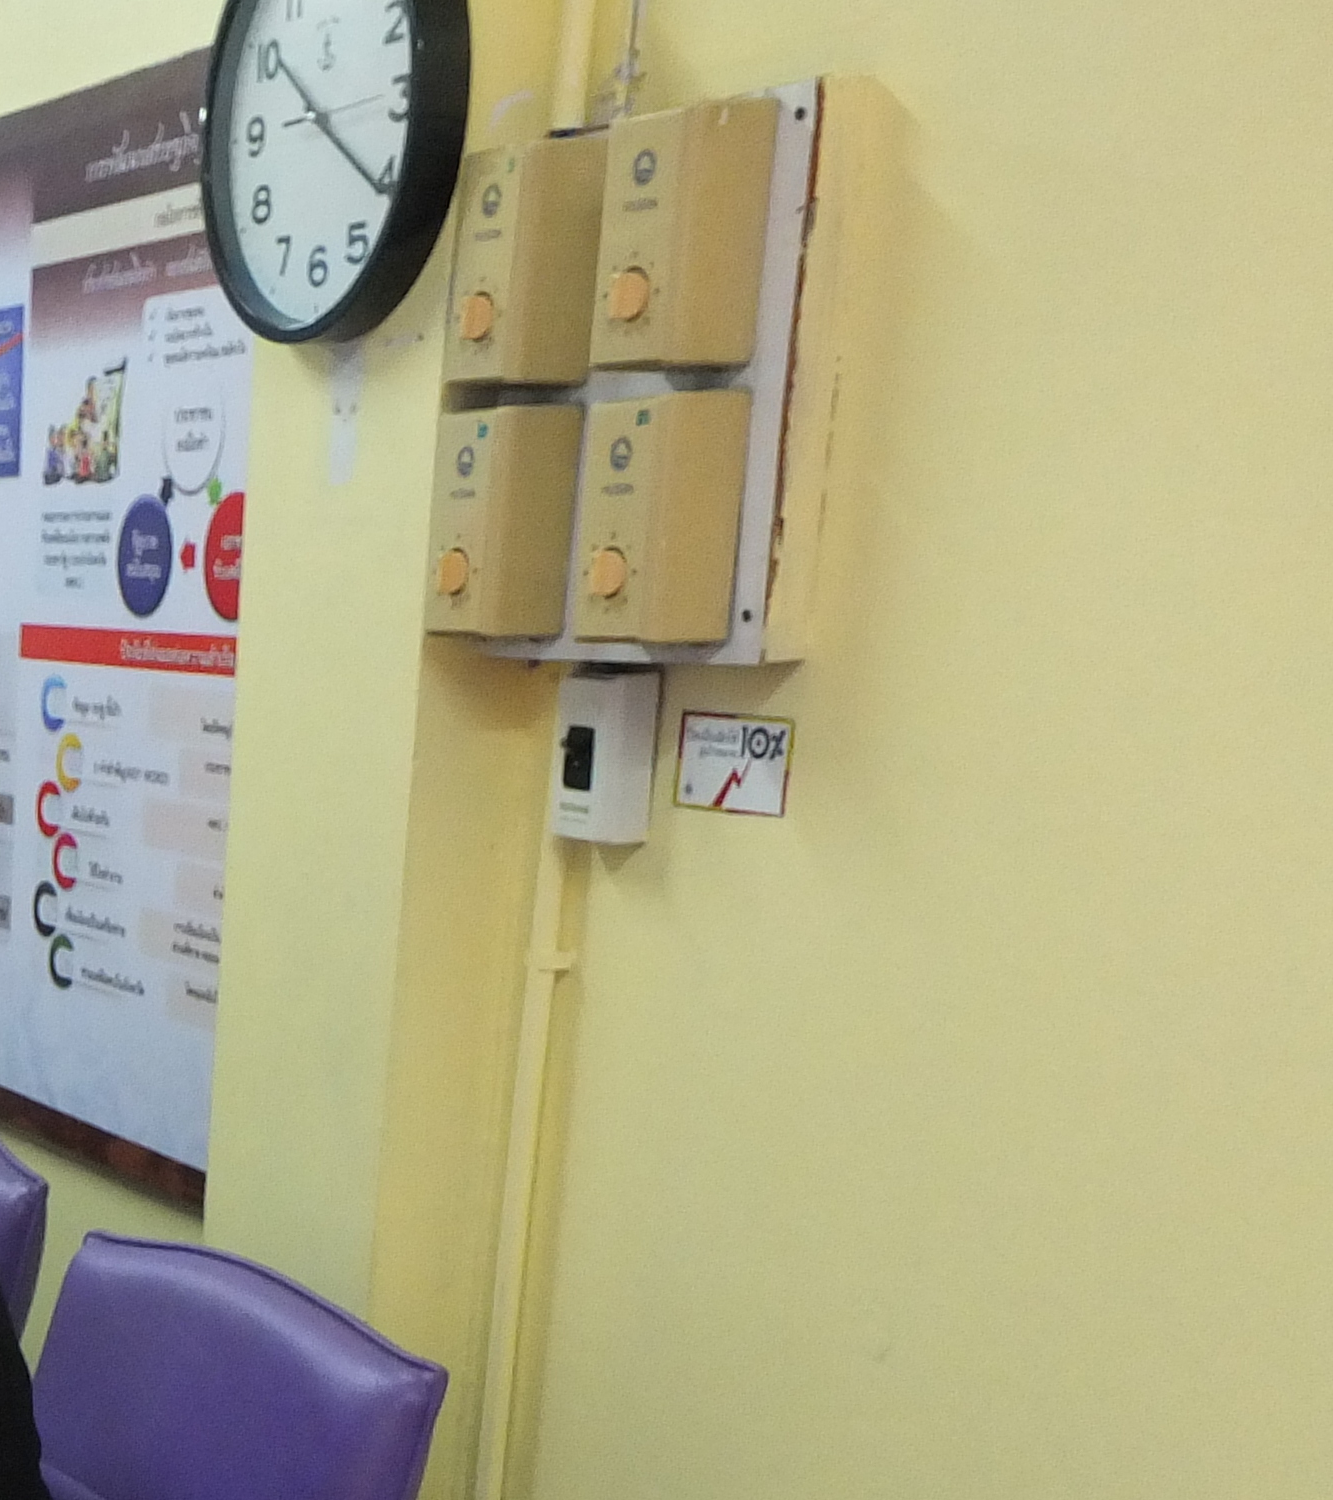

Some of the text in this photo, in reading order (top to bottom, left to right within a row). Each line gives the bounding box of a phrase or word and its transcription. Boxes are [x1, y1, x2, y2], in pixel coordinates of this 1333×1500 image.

[385, 0, 405, 45] 2
[257, 39, 280, 83] 10
[388, 74, 412, 123] 3
[246, 116, 266, 158] 9
[250, 184, 272, 226] 8
[276, 235, 293, 277] 7
[344, 220, 370, 265] 5
[306, 244, 328, 288] 6
[740, 725, 787, 760] 10%
